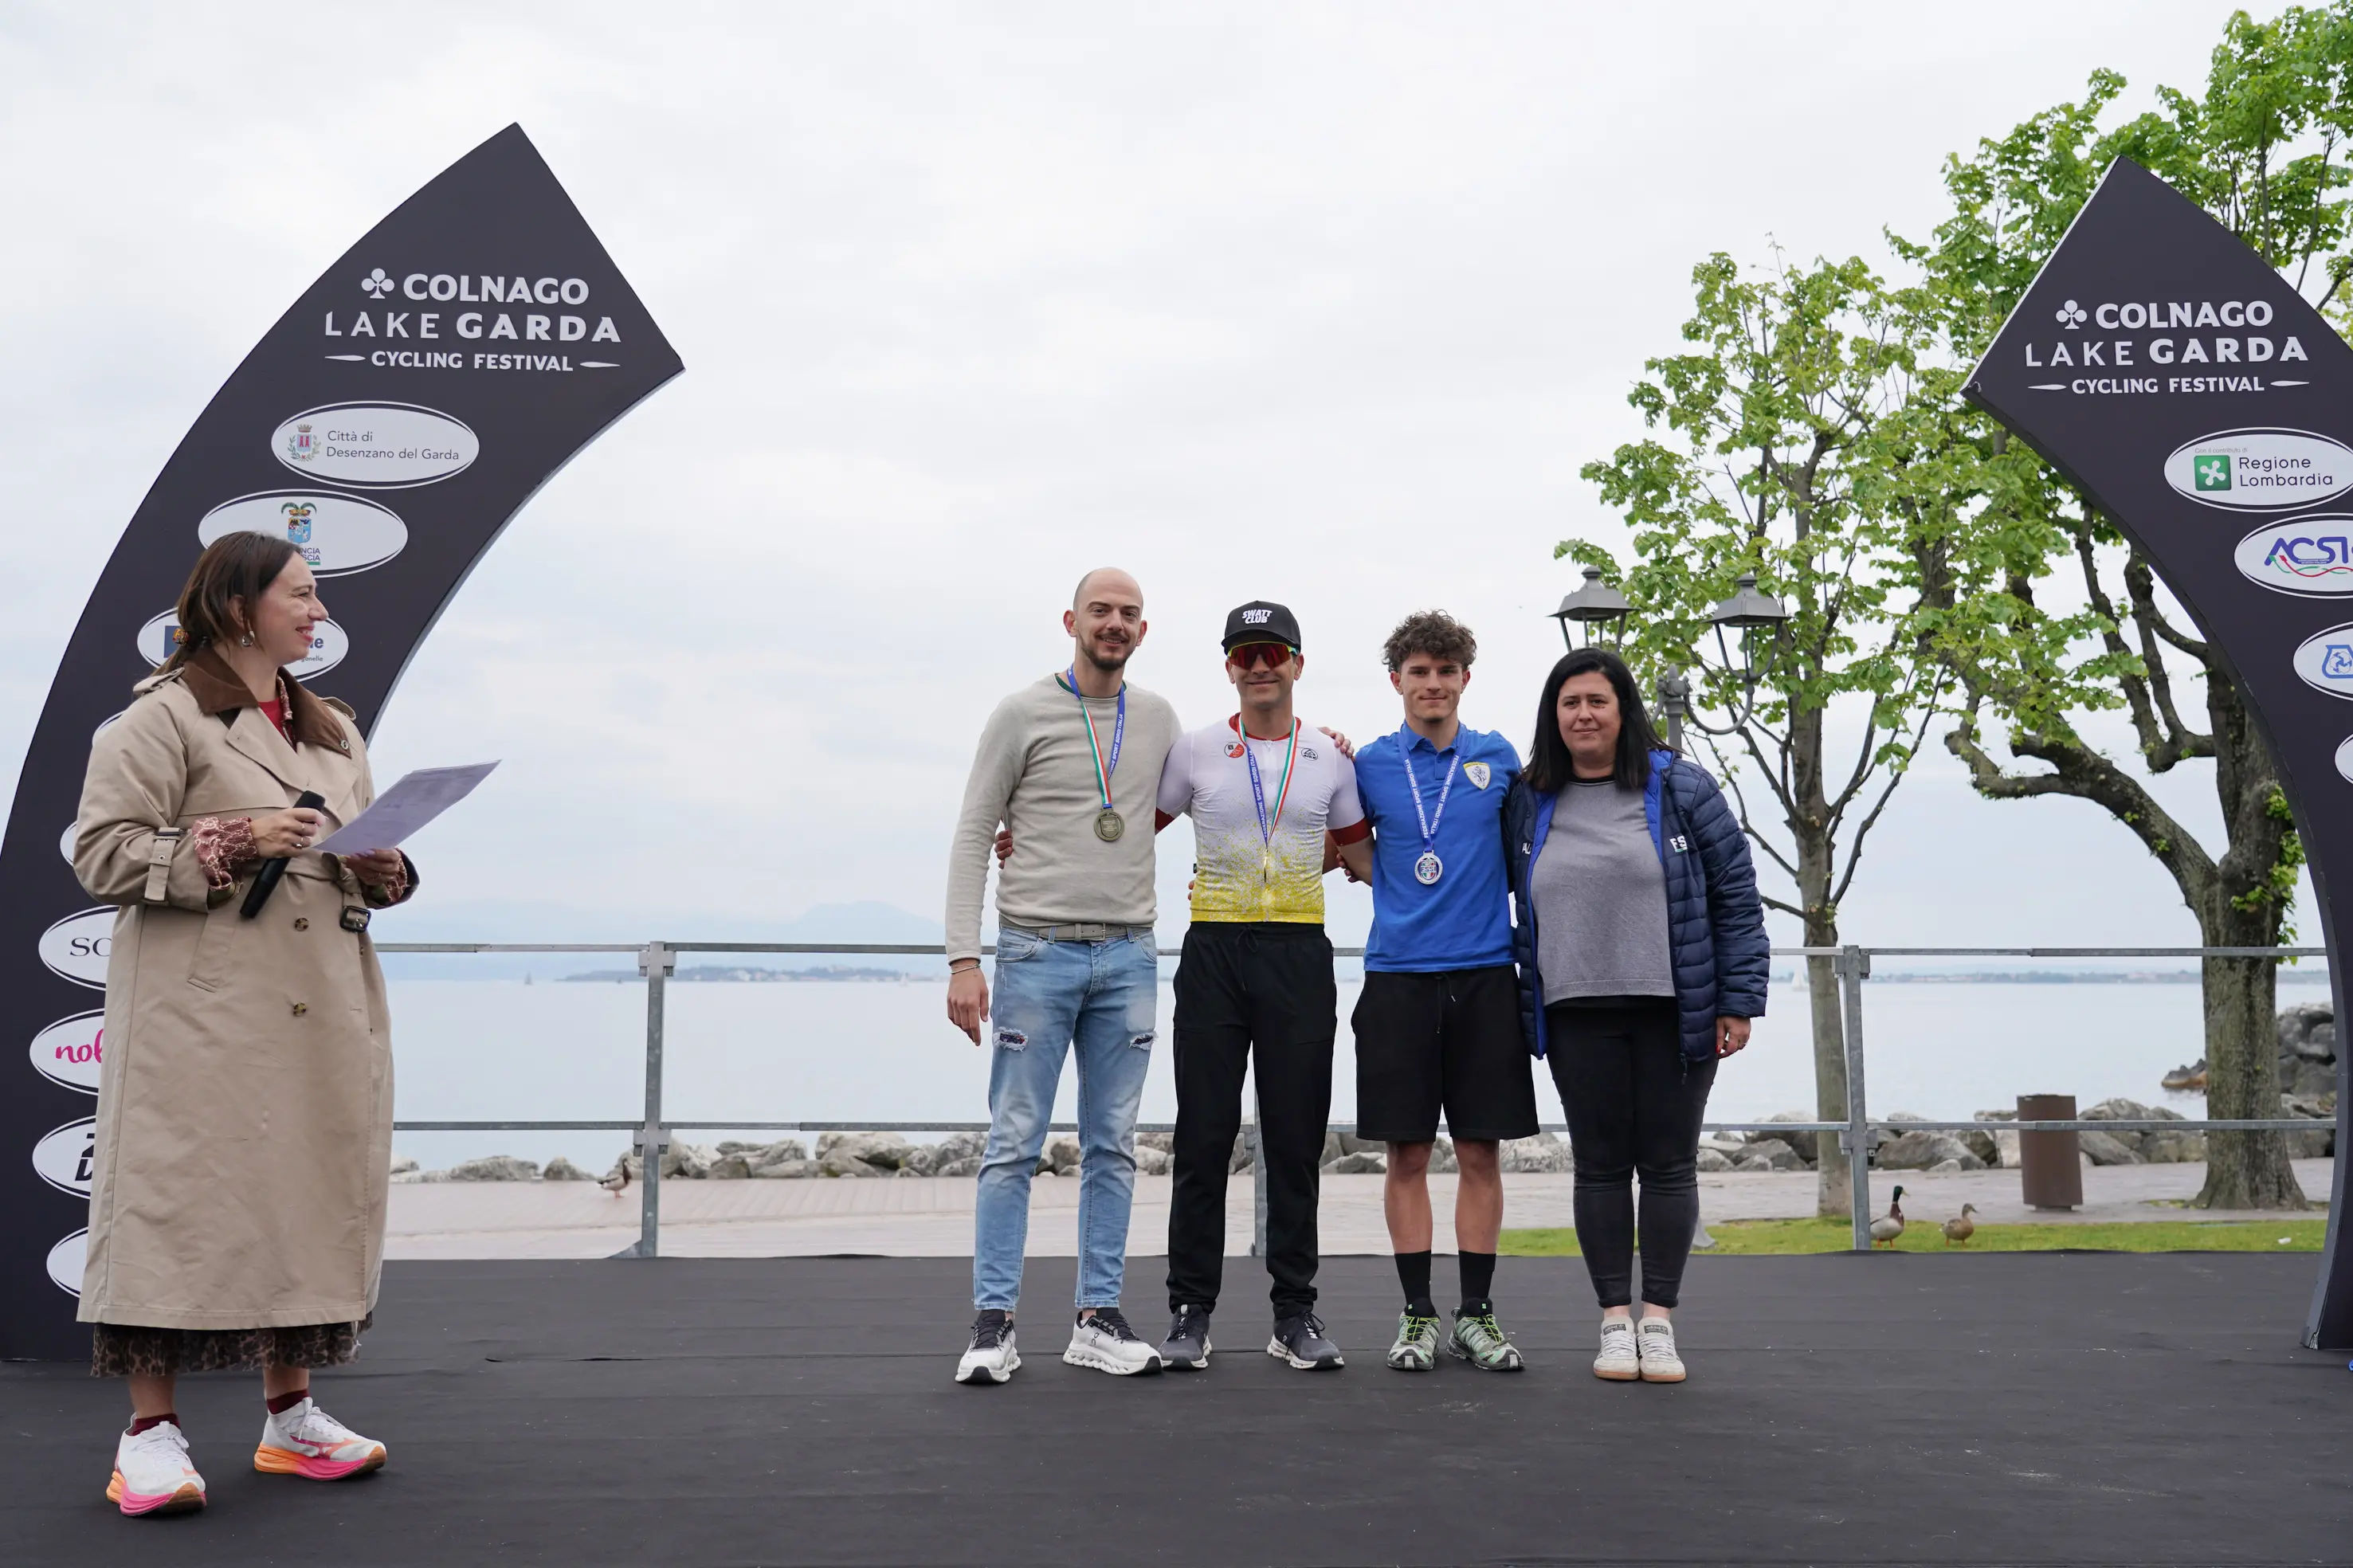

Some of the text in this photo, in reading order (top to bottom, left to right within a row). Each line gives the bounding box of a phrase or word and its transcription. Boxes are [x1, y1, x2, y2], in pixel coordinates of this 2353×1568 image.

[402, 273, 590, 305] COLNAGO
[2095, 300, 2273, 329] COLNAGO
[324, 311, 622, 343] LAKE GARDA
[2025, 336, 2309, 367] LAKE GARDA
[371, 351, 574, 371] CYCLING FESTIVAL
[2072, 376, 2265, 394] CYCLING FESTIVAL
[327, 430, 373, 441] Città di
[326, 446, 460, 460] Desenzano del Garda
[2238, 457, 2311, 472] Regione
[2240, 473, 2333, 487] Lombardia
[1242, 610, 1273, 618] SWATT
[1445, 755, 1460, 786] FEDERAZIONE
[1413, 788, 1422, 804] SPORT
[1440, 786, 1449, 802] SPORT
[1417, 804, 1429, 838] FEDERAZIONE
[1430, 818, 1439, 834] ITALIA
